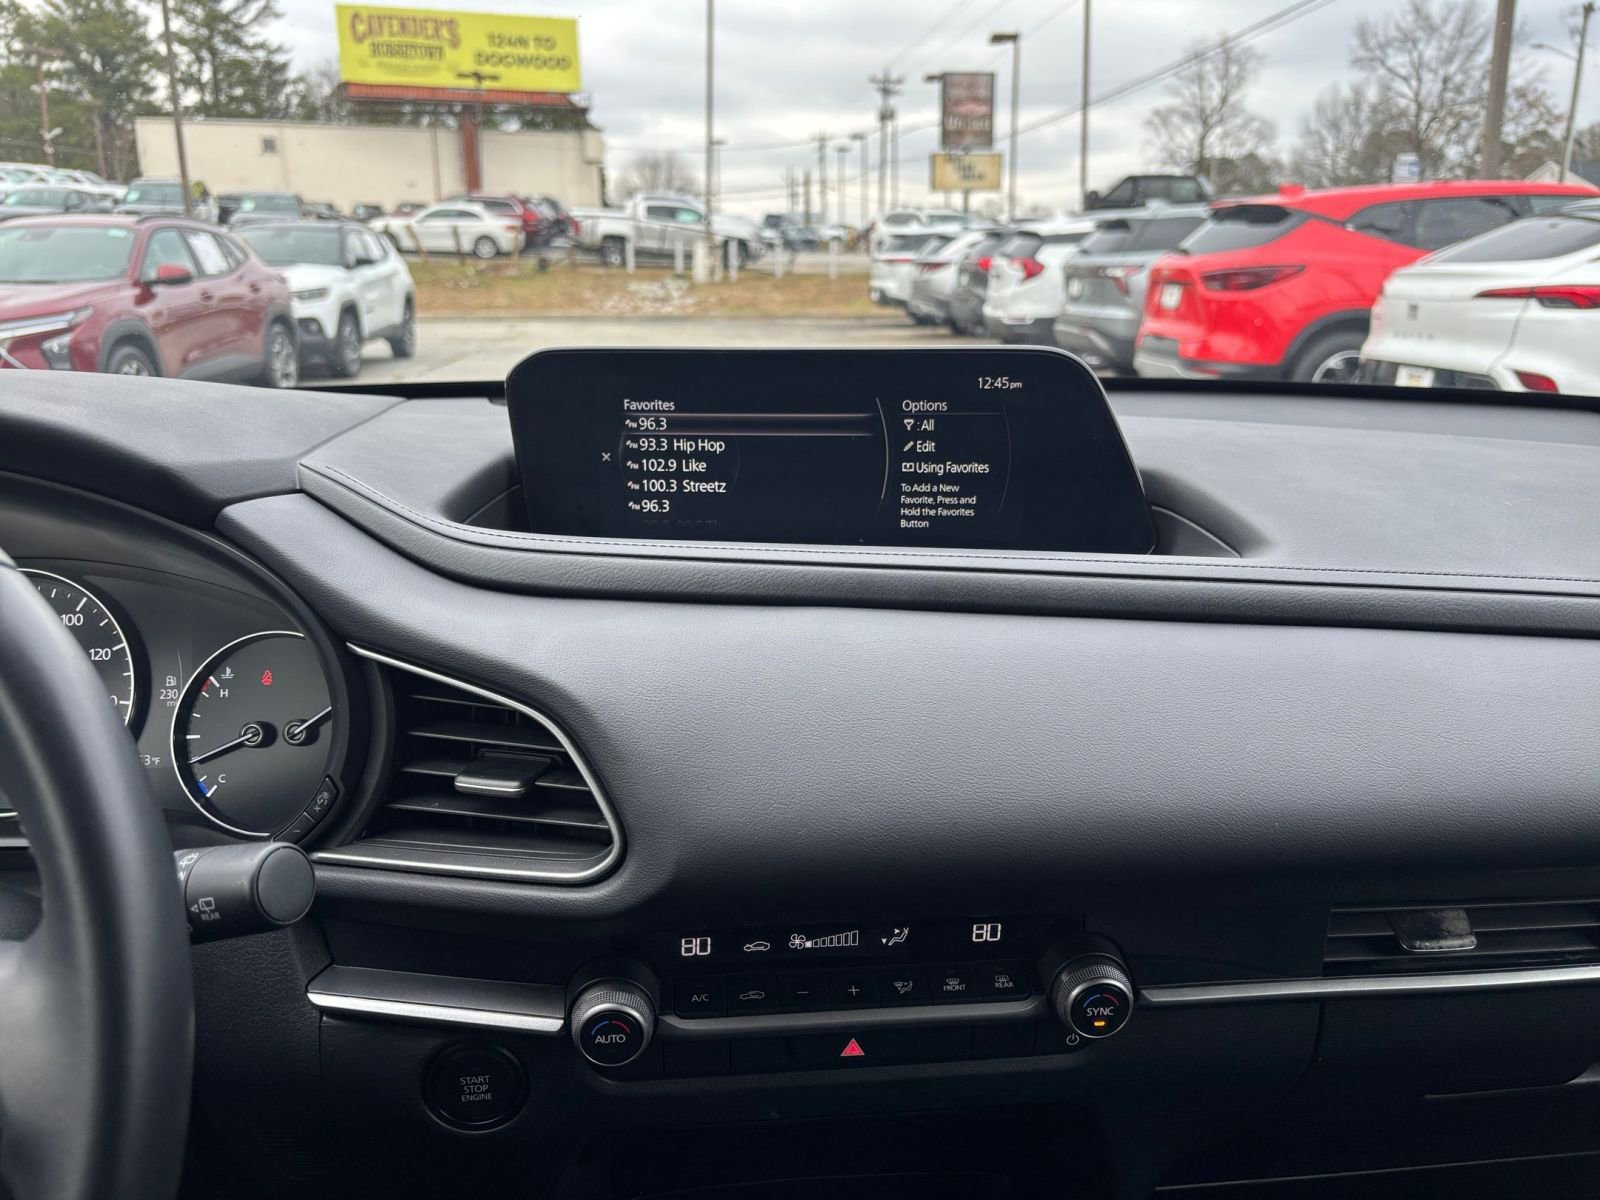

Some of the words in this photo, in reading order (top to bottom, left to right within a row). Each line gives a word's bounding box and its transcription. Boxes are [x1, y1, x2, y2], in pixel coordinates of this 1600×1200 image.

[624, 399, 675, 410] Favorites
[902, 400, 948, 413] Options
[638, 418, 667, 430] 96.3
[640, 438, 668, 451] 93.3
[673, 439, 696, 454] Hip
[698, 439, 726, 454] Hop
[916, 440, 936, 452] Edit
[641, 459, 676, 472] 102.9
[682, 458, 707, 472] Like
[916, 462, 944, 476] Using
[946, 462, 990, 474] Favorites
[642, 479, 677, 492] 100.3
[682, 479, 726, 492] Streetz
[900, 484, 911, 492] To
[912, 483, 930, 492] Add
[940, 484, 960, 492] New
[641, 500, 670, 512] 96.3
[900, 496, 935, 505] Favorite,
[937, 496, 958, 504] Press
[960, 496, 976, 504] and
[900, 508, 920, 516] Hold
[922, 508, 936, 516] the
[938, 508, 974, 516] Favorites
[900, 520, 929, 528] Button
[60, 614, 84, 626] 100
[89, 648, 111, 660] 120
[160, 689, 178, 700] 230
[220, 689, 228, 698] H
[218, 774, 226, 783] C
[972, 923, 1001, 942] 80
[681, 937, 711, 956] 80
[994, 980, 1014, 988] REAR
[692, 994, 710, 1002] A/C
[1086, 1006, 1114, 1016] SYNC
[594, 1034, 626, 1044] AUTO
[460, 1075, 490, 1086] START
[464, 1084, 488, 1094] STOP
[462, 1092, 492, 1102] ENGINE
